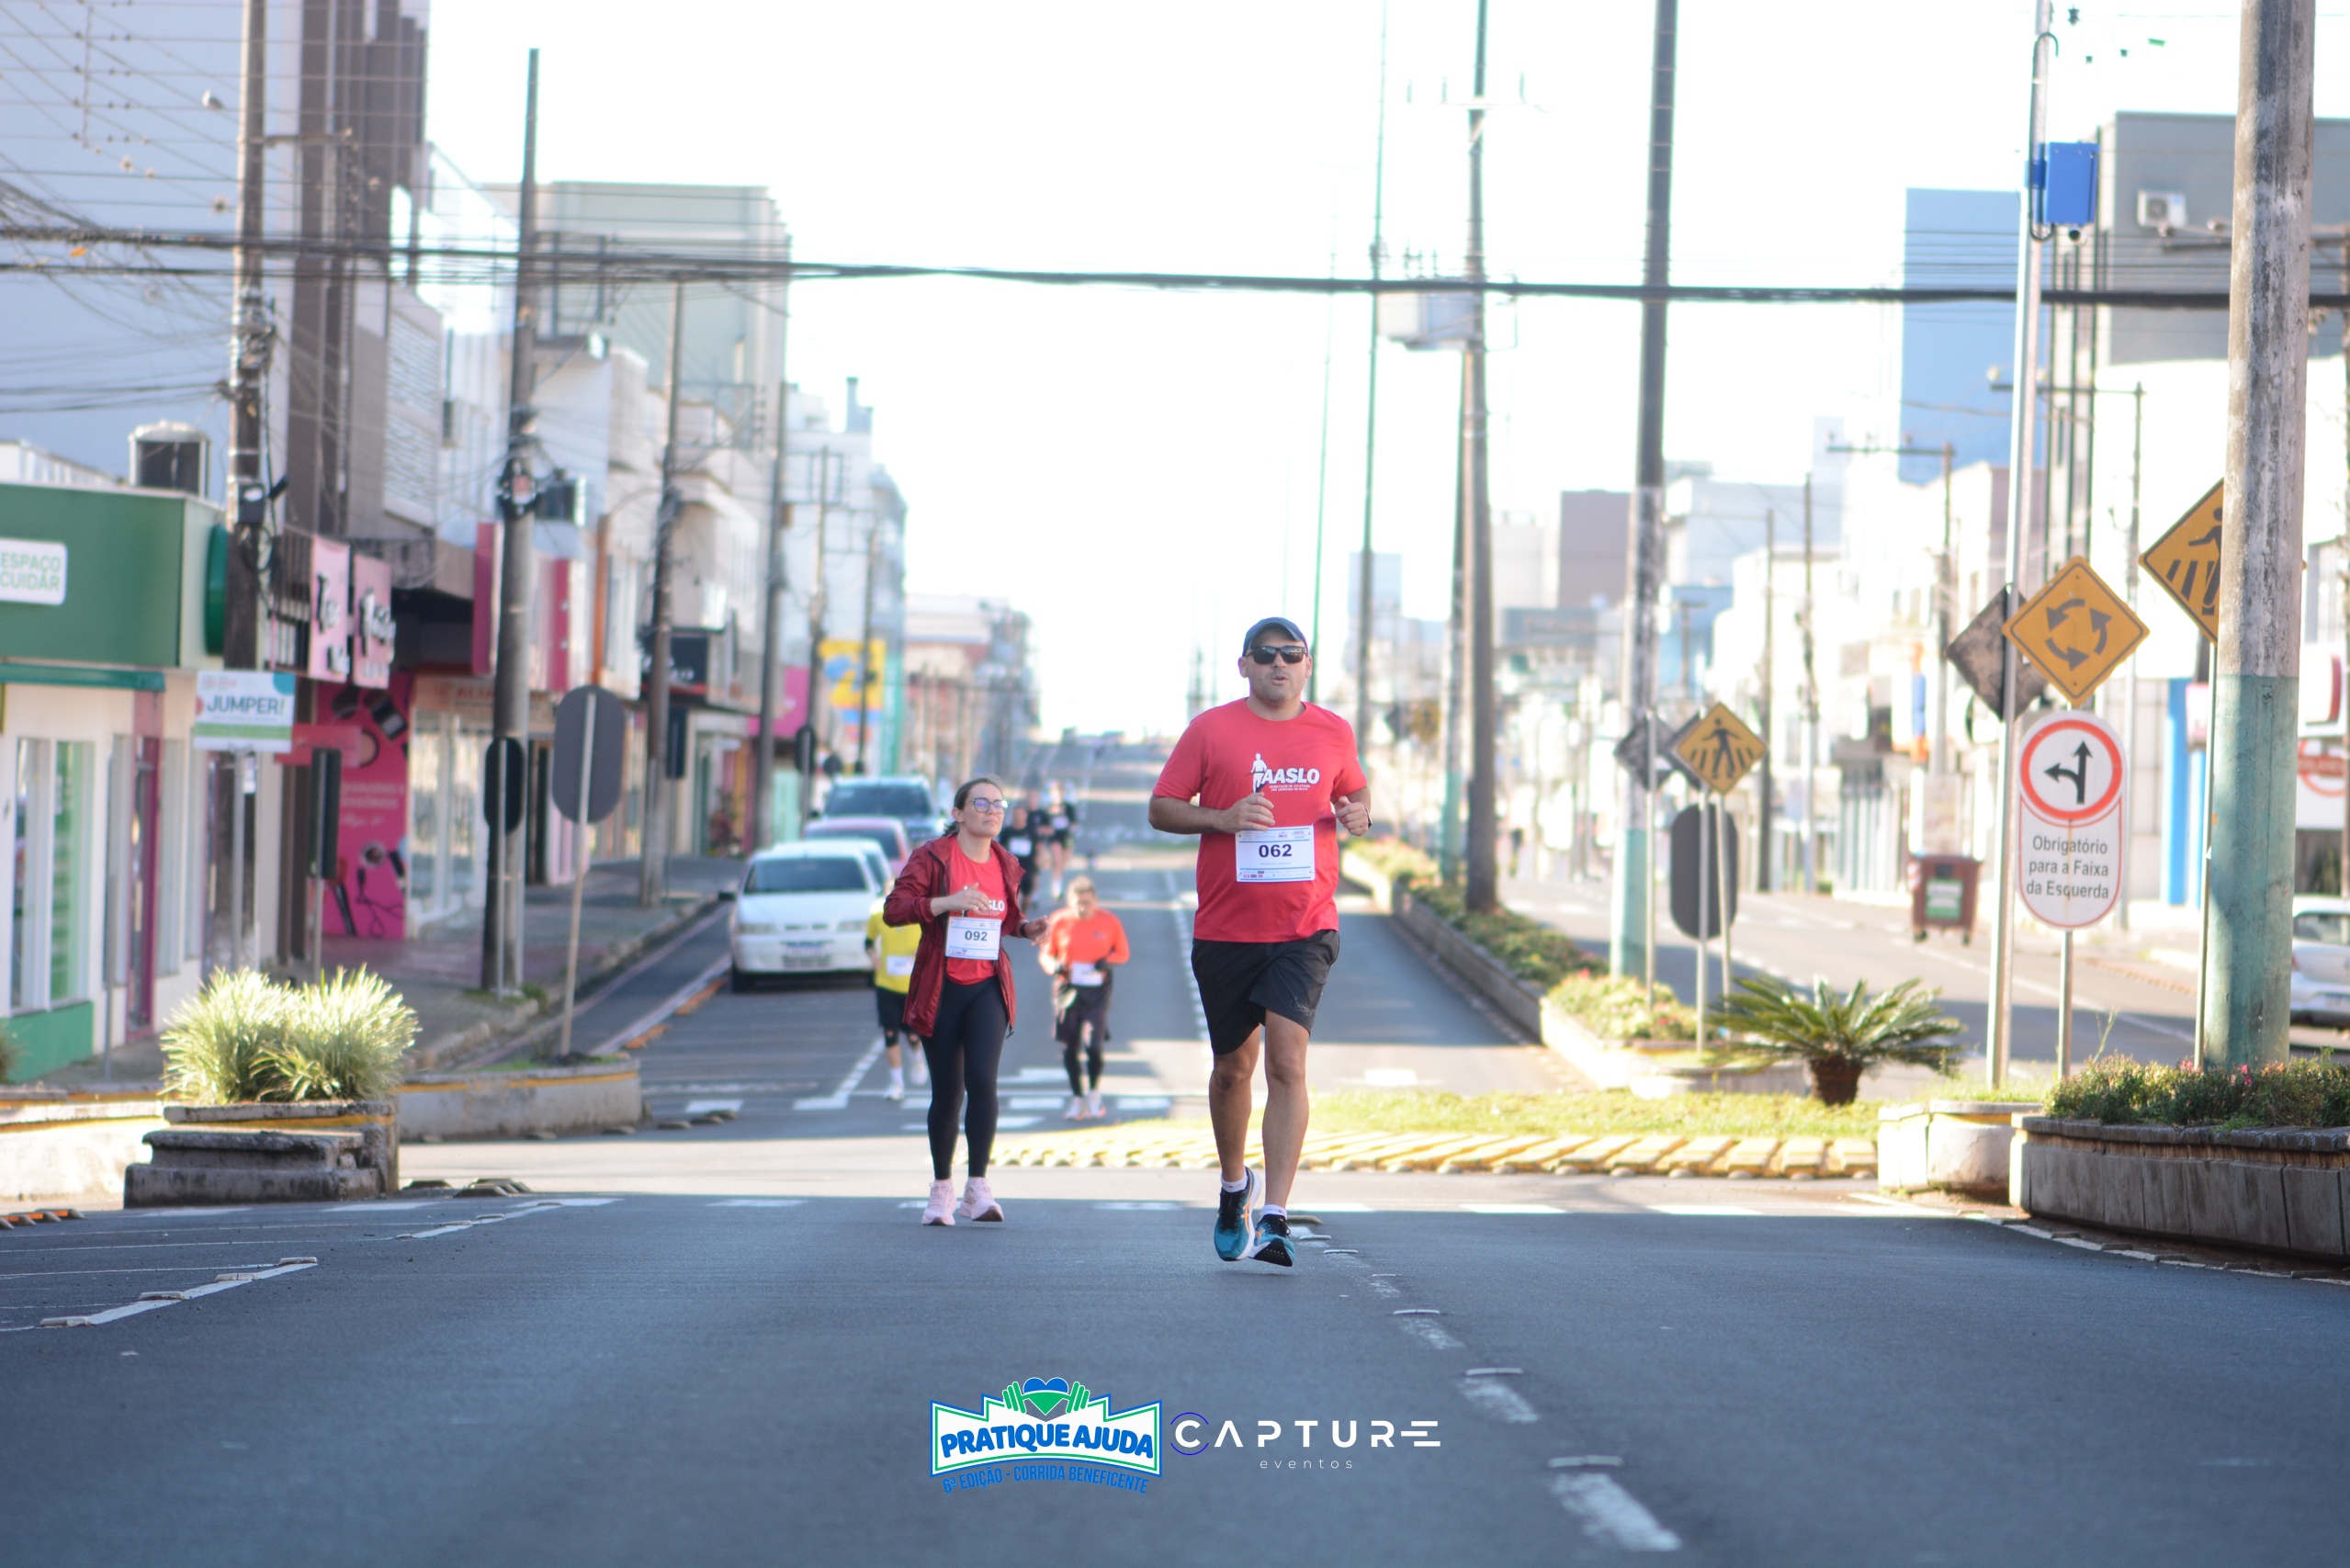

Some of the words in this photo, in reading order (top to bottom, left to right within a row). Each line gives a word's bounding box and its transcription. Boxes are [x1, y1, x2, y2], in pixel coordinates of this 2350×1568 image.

[1, 552, 62, 573] ESPAÇO
[0, 570, 61, 592] CUIDAR
[207, 695, 285, 716] JUMPER!
[1261, 768, 1320, 784] AASLO
[1259, 844, 1293, 858] 062
[2033, 835, 2107, 855] Obrigatório
[2028, 861, 2058, 875] para
[2062, 863, 2069, 874] a
[2073, 860, 2108, 876] Faixa
[2026, 879, 2042, 895] da
[2046, 880, 2108, 900] Esquerda
[965, 930, 988, 942] 092
